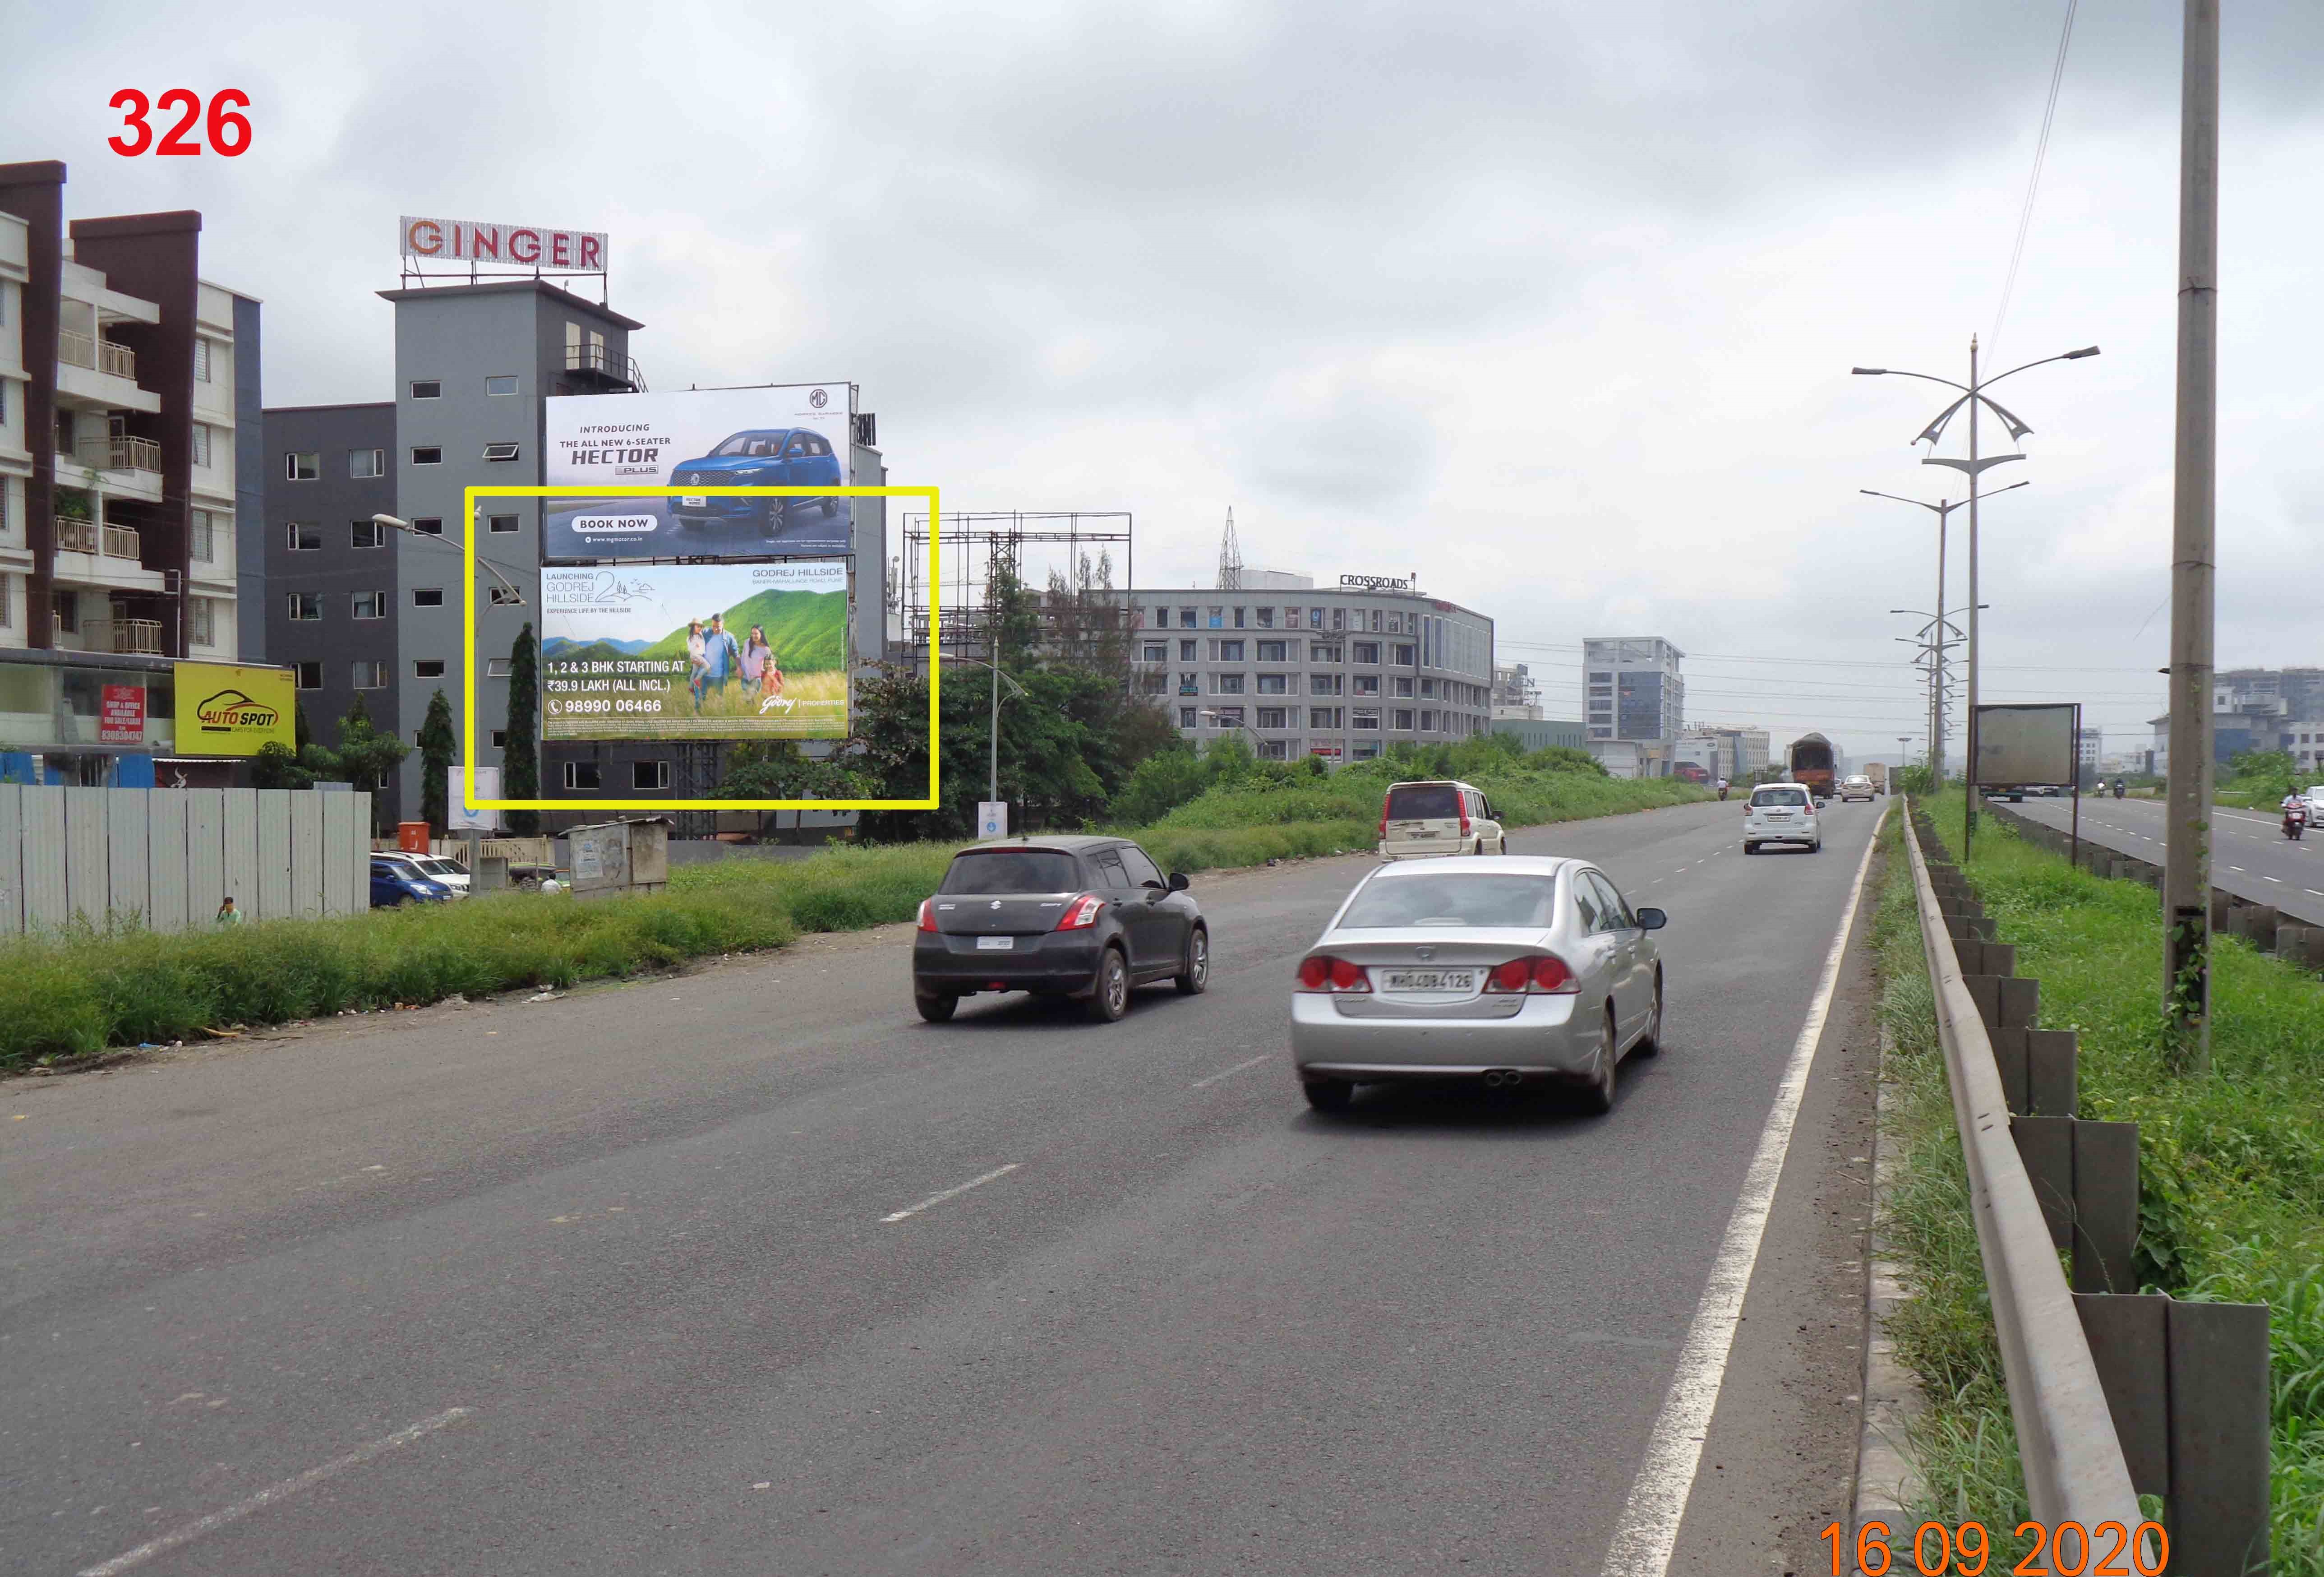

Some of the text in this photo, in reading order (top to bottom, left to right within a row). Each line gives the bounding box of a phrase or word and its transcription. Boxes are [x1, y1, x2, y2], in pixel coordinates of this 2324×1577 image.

[409, 221, 599, 268] GINGER
[811, 390, 826, 406] MG
[580, 424, 650, 434] INTRODUCING
[626, 437, 671, 445] 6-SEATER
[572, 448, 659, 465] HECTOR
[580, 519, 649, 528] BOOK NOW
[753, 568, 844, 577] GODREJ HILLSIDE
[546, 582, 594, 592] GODREJ
[1341, 574, 1408, 589] CROSSROADS
[546, 593, 593, 603] HILLSIDE
[548, 661, 685, 675] 1, 2 & 3 BHK STARTING AT
[547, 679, 670, 693] ₹39.9 LAKH (ALL INCL.)
[565, 700, 662, 712] 98990 06466
[202, 710, 275, 726] AUTO SPOT
